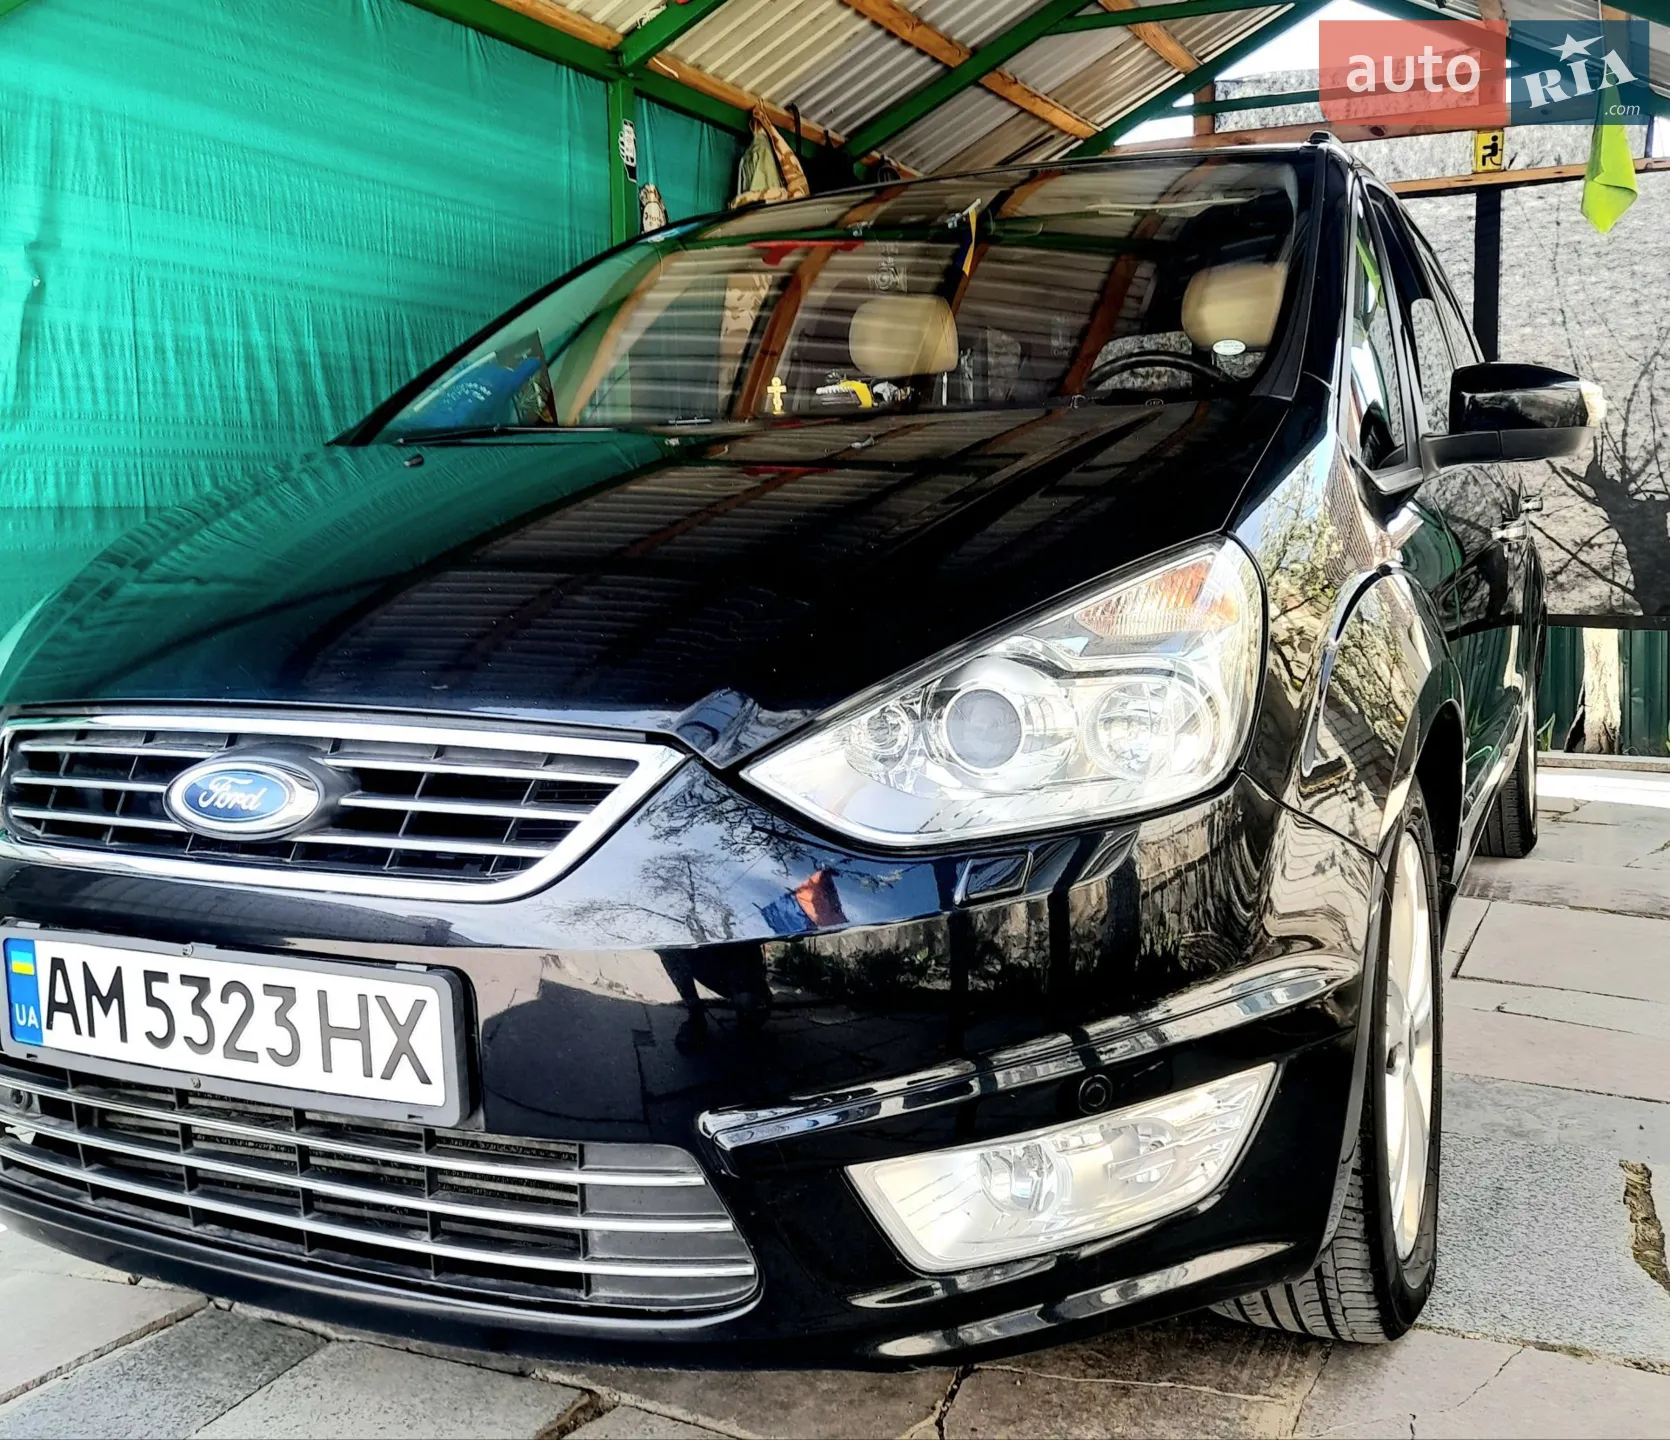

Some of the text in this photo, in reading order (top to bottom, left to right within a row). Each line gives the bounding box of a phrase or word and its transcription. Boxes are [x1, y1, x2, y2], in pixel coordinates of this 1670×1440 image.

[198, 775, 268, 812] Ford
[15, 1002, 40, 1030] UA
[46, 957, 433, 1086] AM 5323 HX
